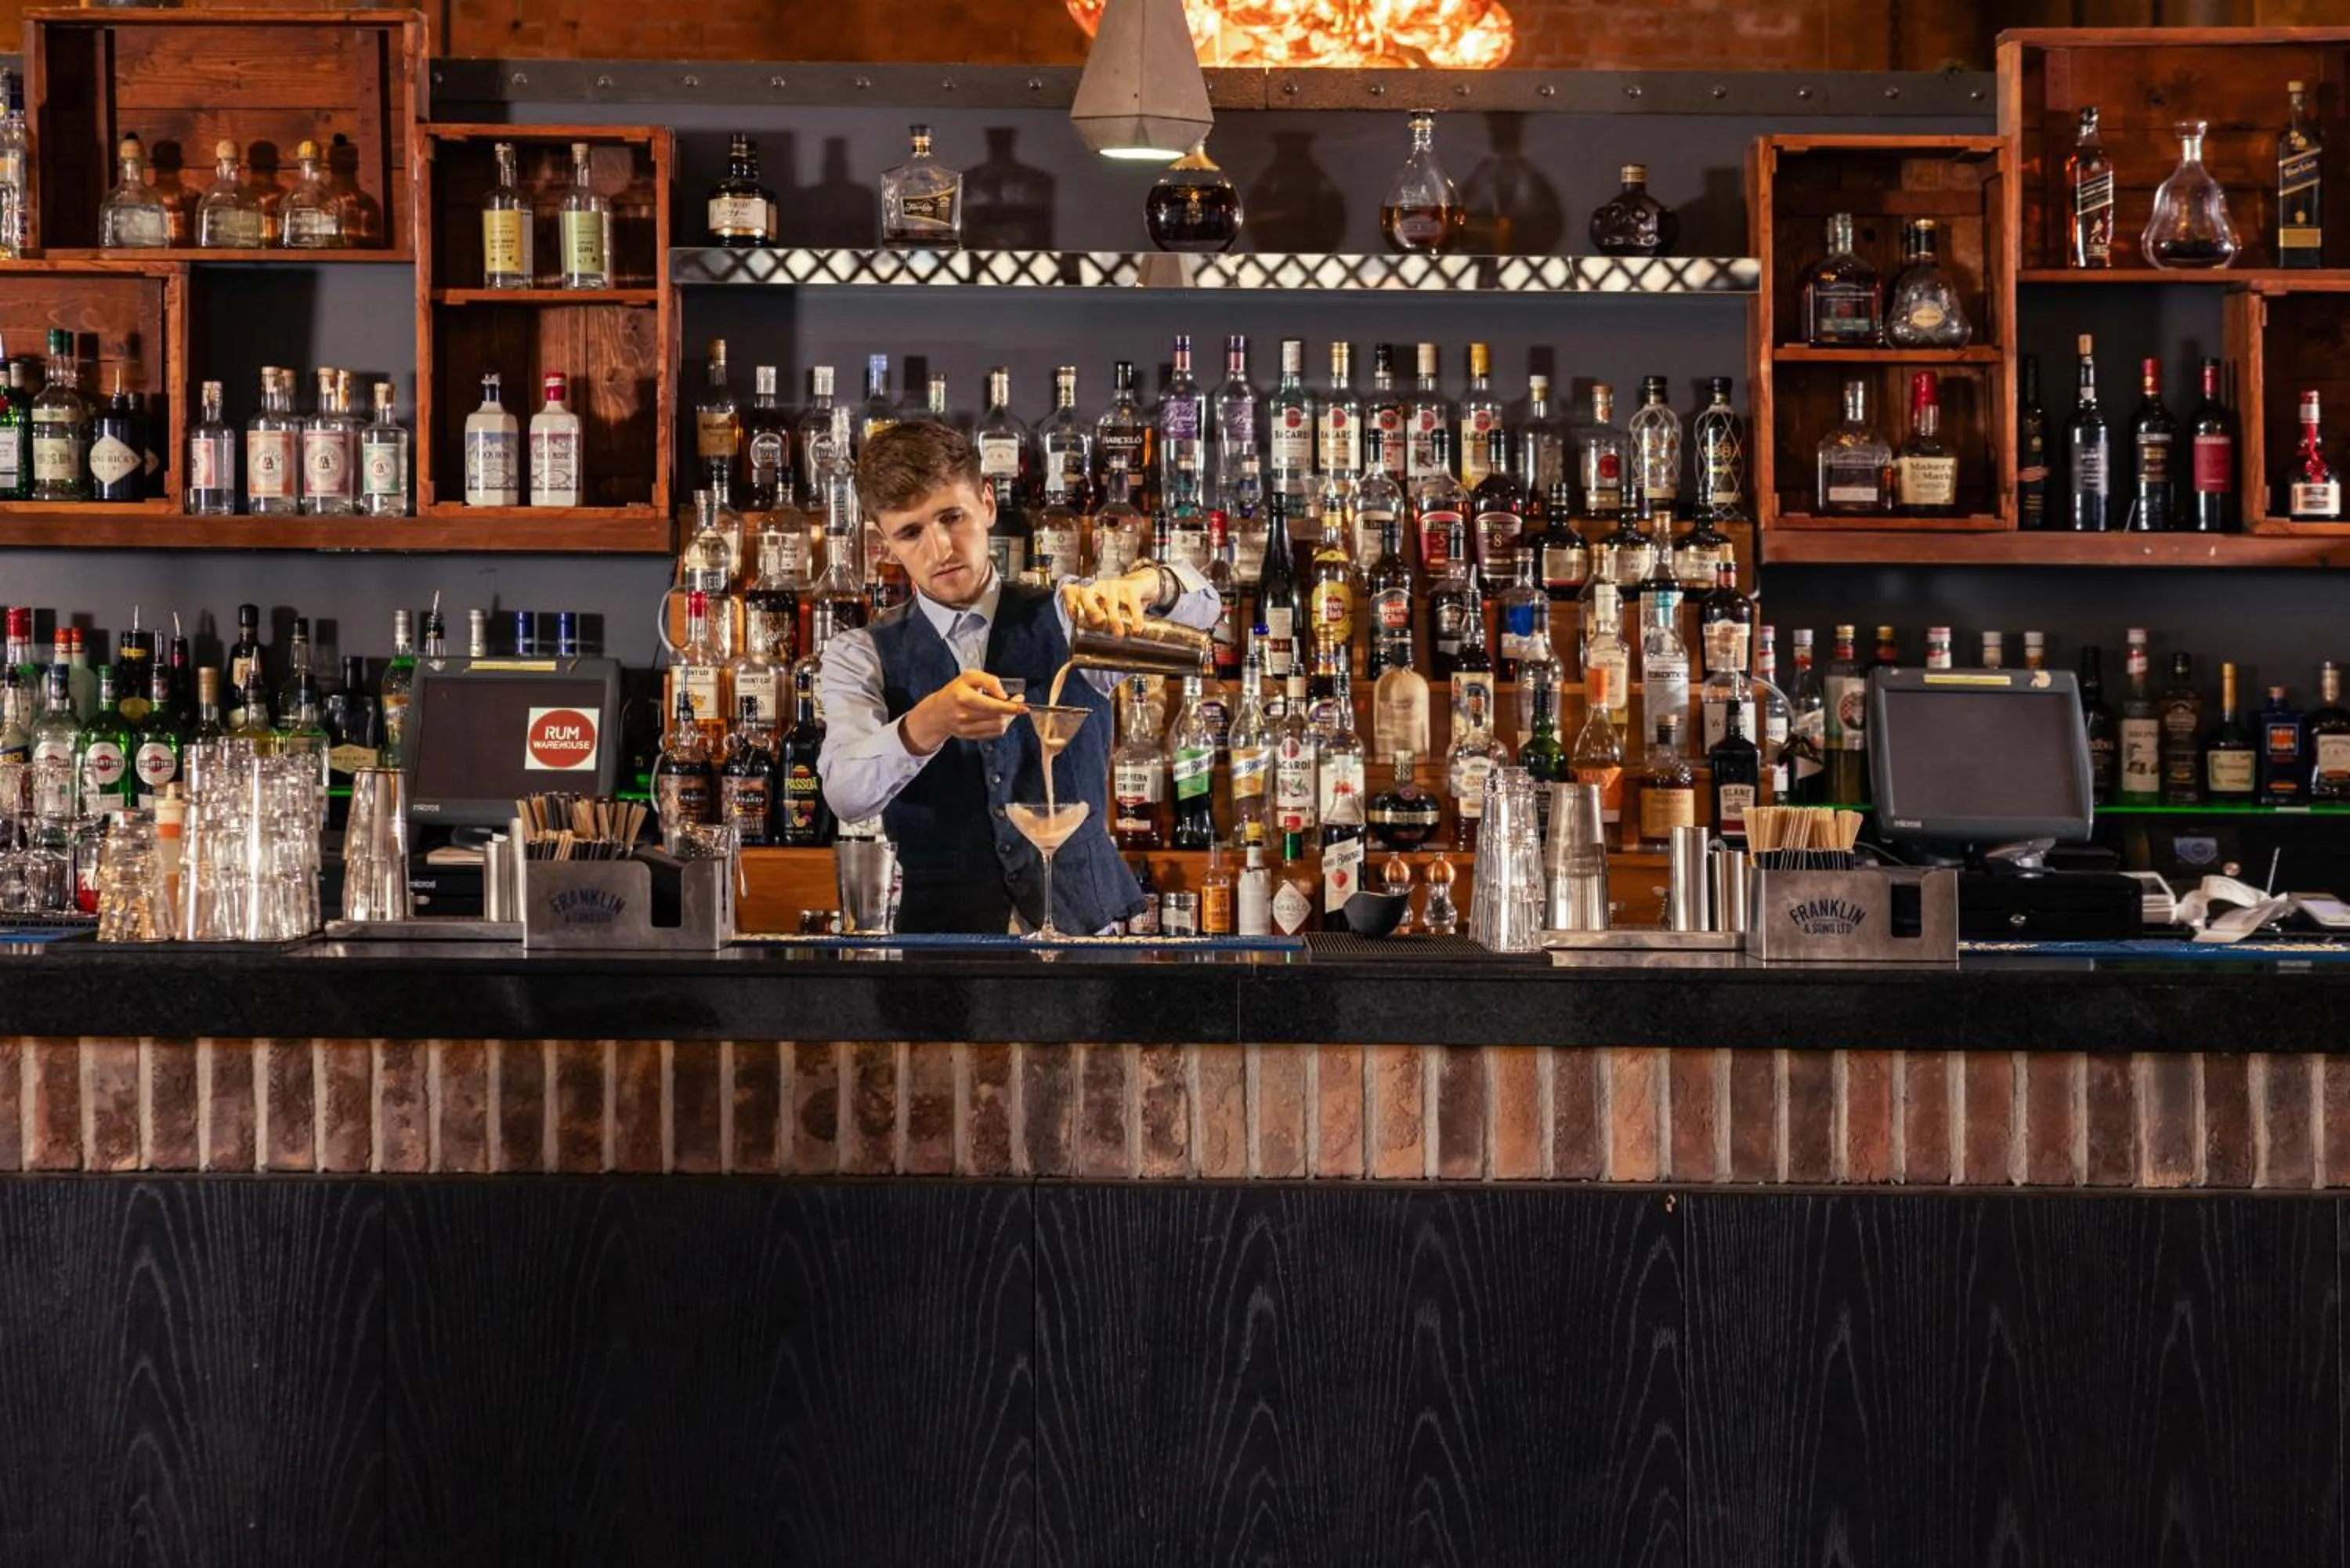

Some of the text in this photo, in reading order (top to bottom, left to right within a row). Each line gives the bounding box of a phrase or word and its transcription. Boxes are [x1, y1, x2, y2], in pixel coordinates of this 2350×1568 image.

[1493, 533, 1502, 547] 8
[544, 725, 580, 740] RUM
[533, 740, 591, 750] WAREHOUSE
[550, 888, 627, 916] FRANKLIN
[1789, 898, 1866, 926] FRANKLIN
